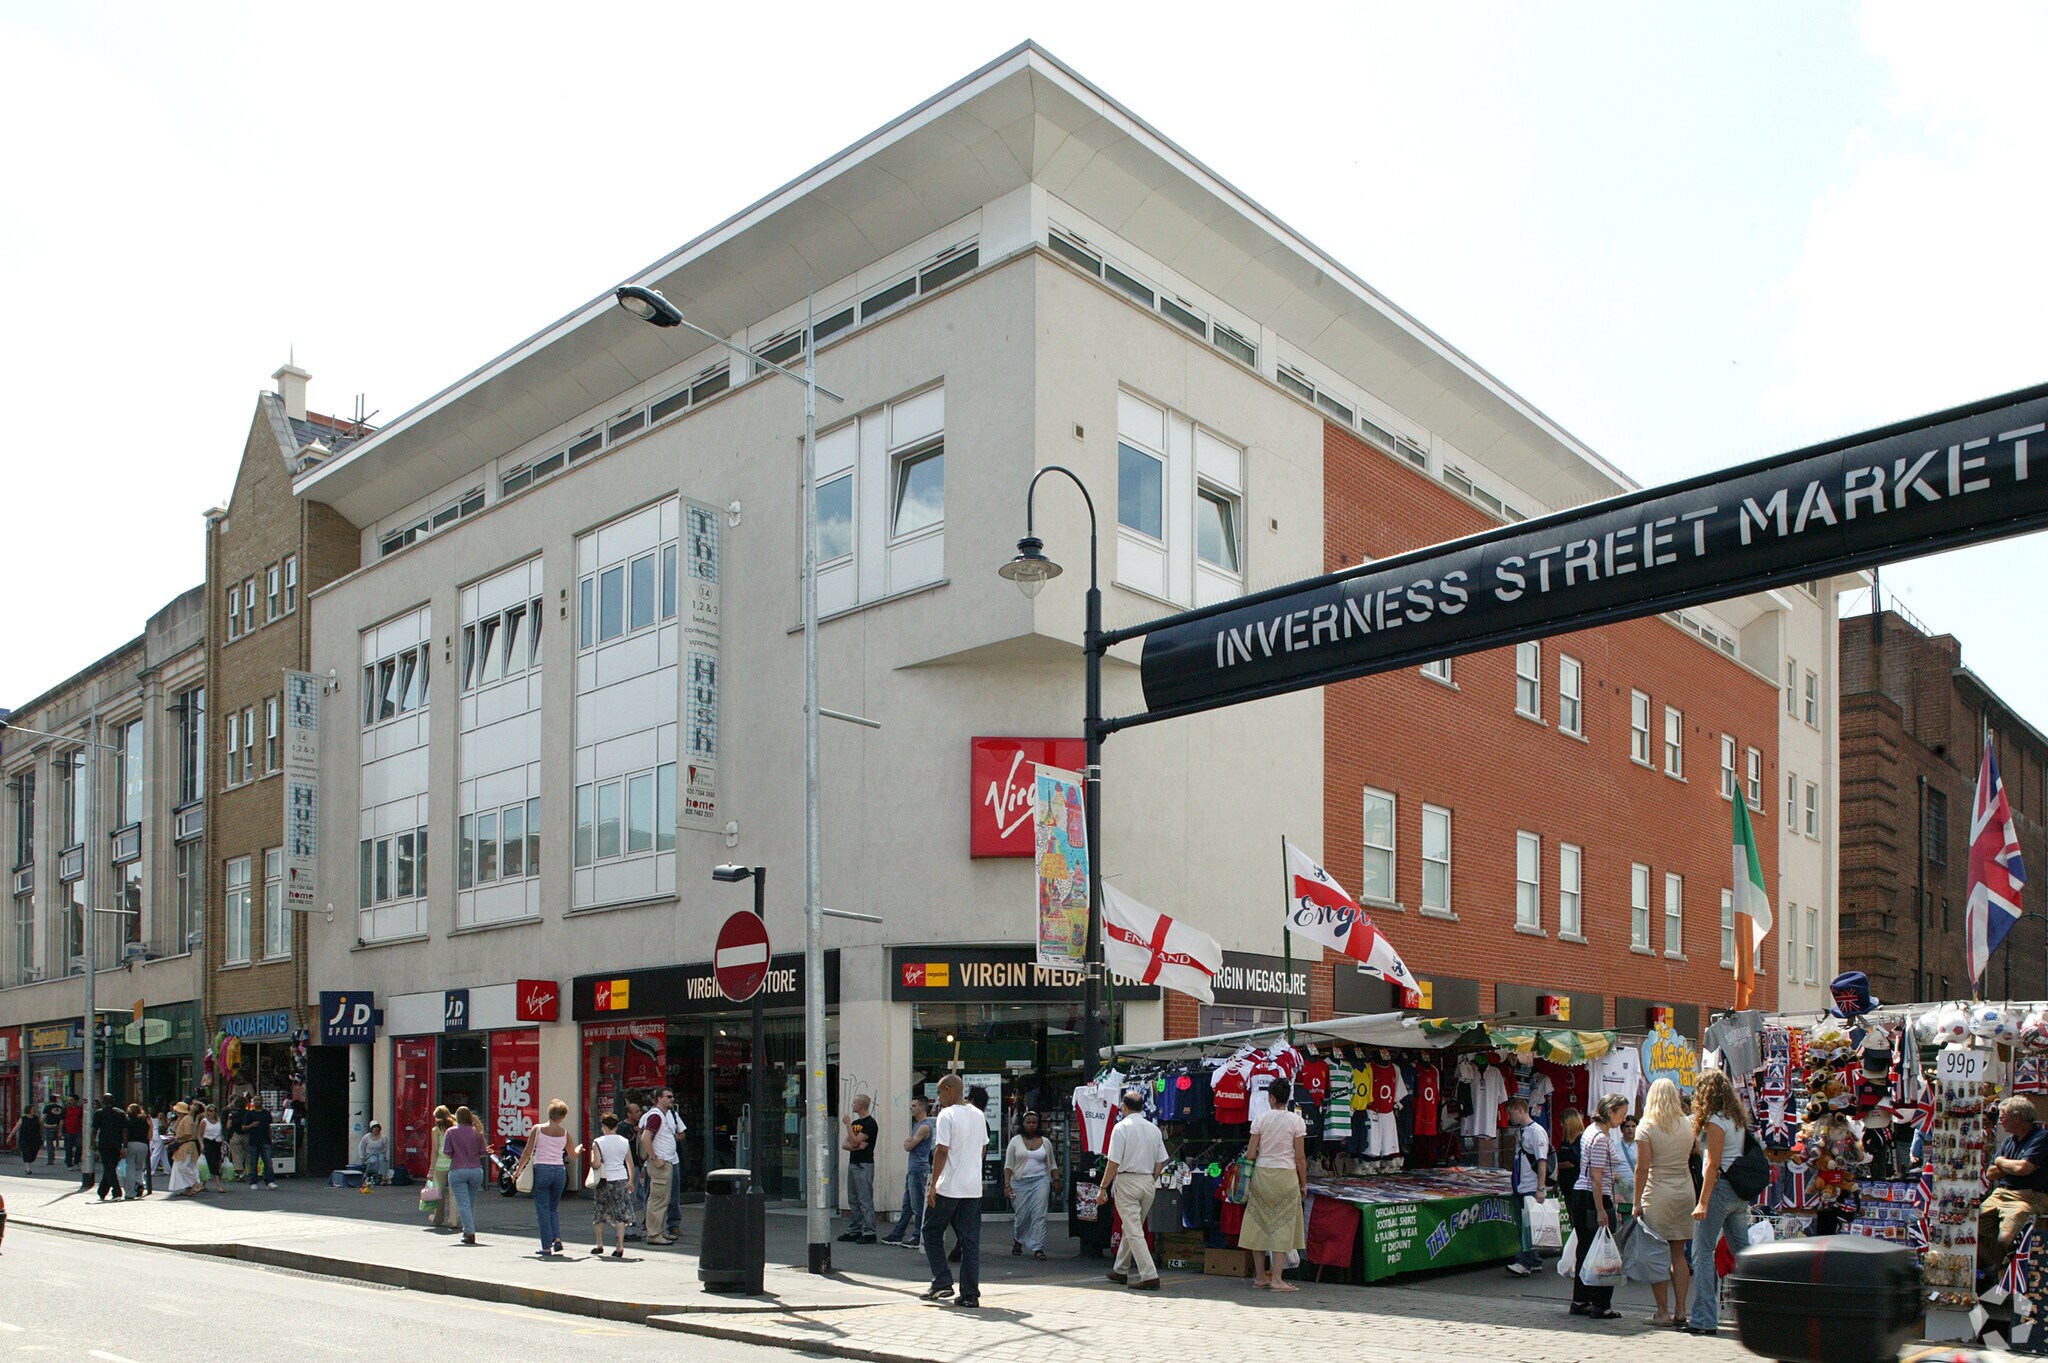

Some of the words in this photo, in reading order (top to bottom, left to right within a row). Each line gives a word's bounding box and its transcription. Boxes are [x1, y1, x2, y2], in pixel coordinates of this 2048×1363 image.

[1214, 569, 1468, 669] INVERNESS
[1494, 506, 1719, 602] STREET
[1739, 425, 2047, 547] MARKET
[686, 797, 715, 811] home
[959, 962, 1027, 988] VIRGIN
[1213, 966, 1244, 990] IRGIN
[226, 1012, 289, 1038] AQUARIUS
[328, 1026, 368, 1037] SPORTS
[1946, 1052, 1976, 1079] 99p
[498, 1070, 531, 1107] big
[1215, 1090, 1245, 1100] Arsenal
[497, 1110, 533, 1137] sale
[1425, 1219, 1451, 1261] THE
